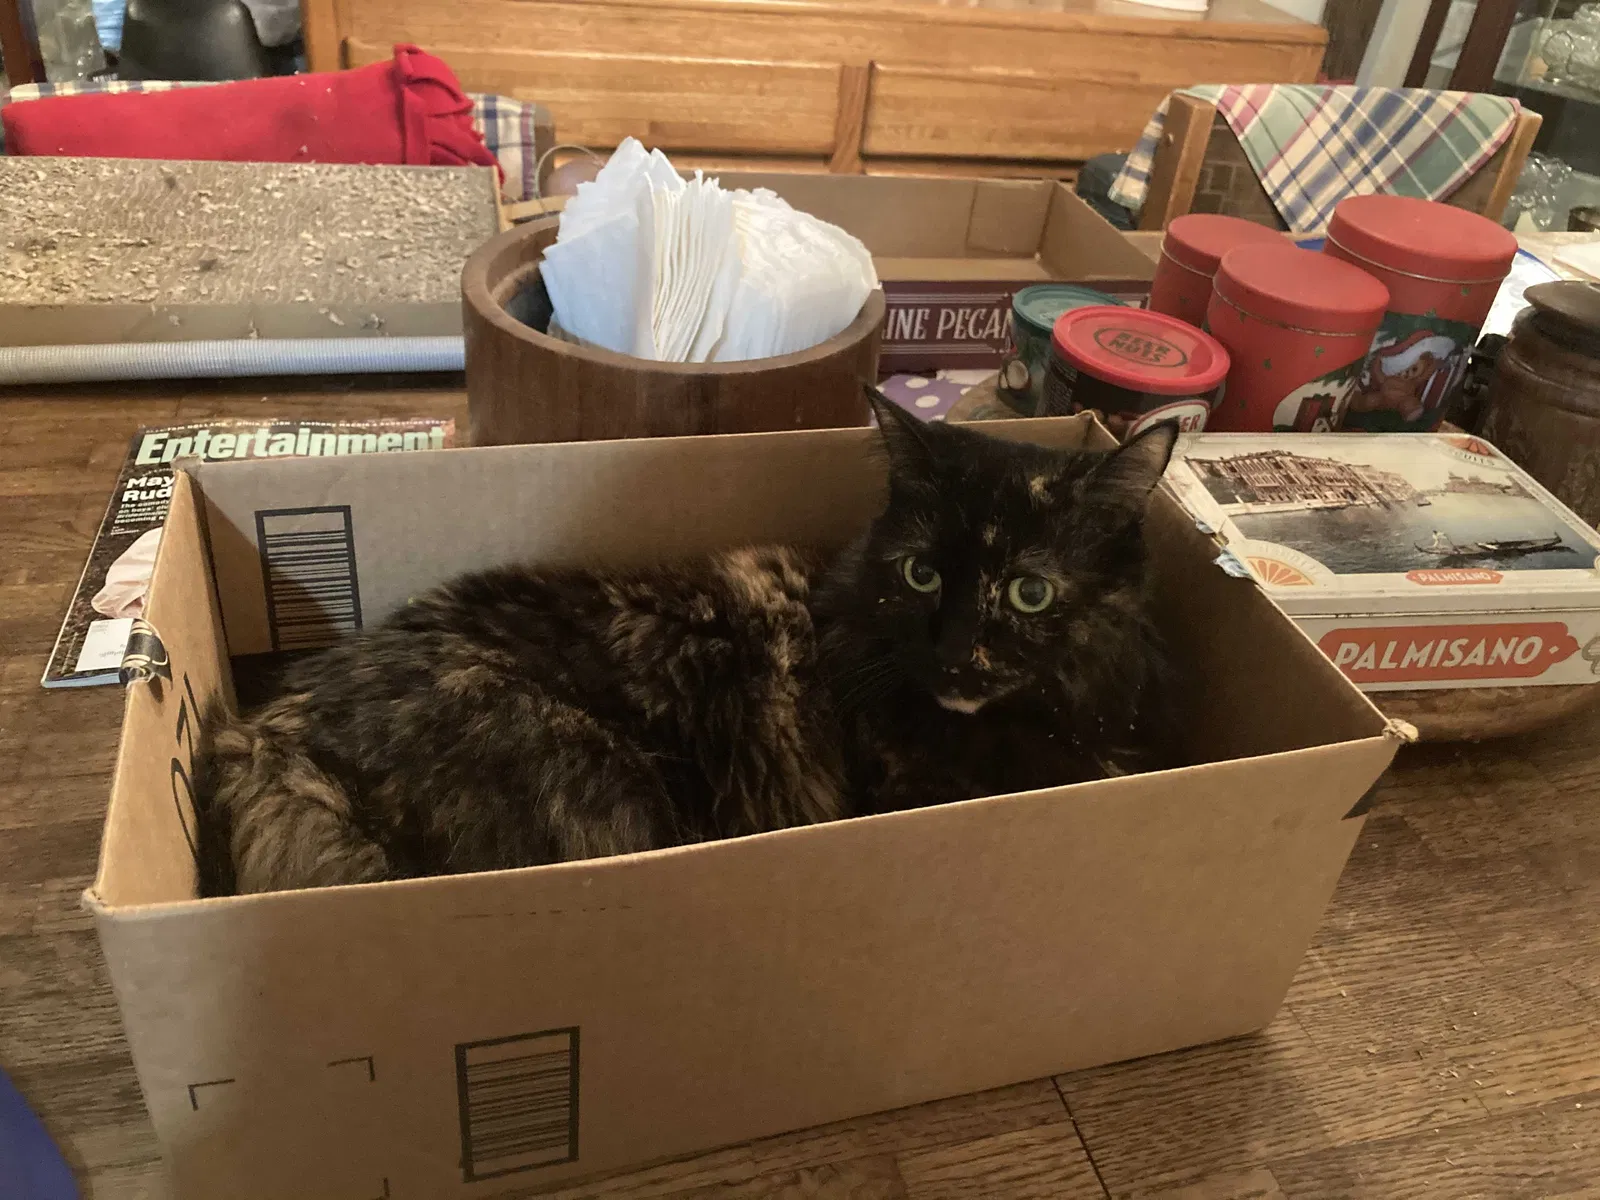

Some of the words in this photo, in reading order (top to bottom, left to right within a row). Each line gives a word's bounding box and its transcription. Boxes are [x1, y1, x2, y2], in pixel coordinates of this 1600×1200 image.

[881, 308, 931, 340] INE
[134, 426, 446, 466] Entertainment
[121, 486, 173, 502] Rud
[126, 476, 175, 489] May
[1418, 571, 1492, 582] PALMISANO
[1334, 635, 1544, 671] PALMISANO
